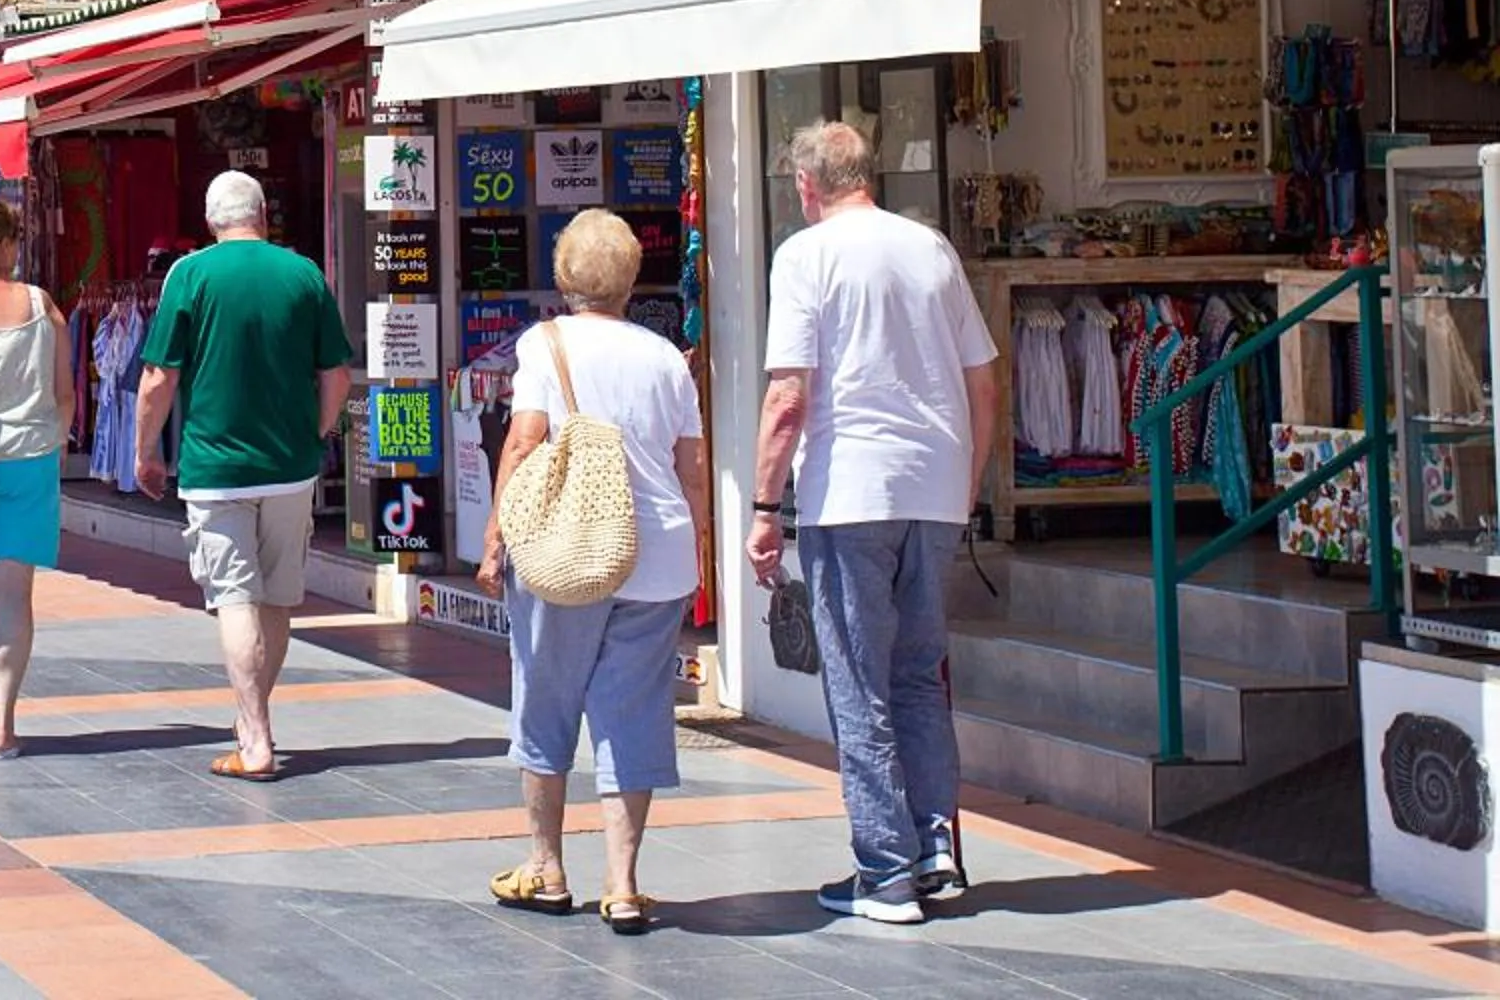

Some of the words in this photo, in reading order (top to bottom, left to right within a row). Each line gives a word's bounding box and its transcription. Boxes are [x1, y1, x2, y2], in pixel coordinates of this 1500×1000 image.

[467, 143, 514, 169] Sexy
[473, 172, 514, 203] 50
[375, 245, 393, 261] 50
[394, 247, 427, 259] YEARS
[375, 261, 386, 271] to
[387, 260, 408, 271] look
[409, 260, 428, 271] this
[399, 272, 428, 284] good
[376, 392, 429, 407] BECAUSE
[377, 407, 399, 424] I'M
[404, 406, 430, 424] THE
[379, 423, 431, 445] BOSS
[378, 535, 430, 548] TikTok
